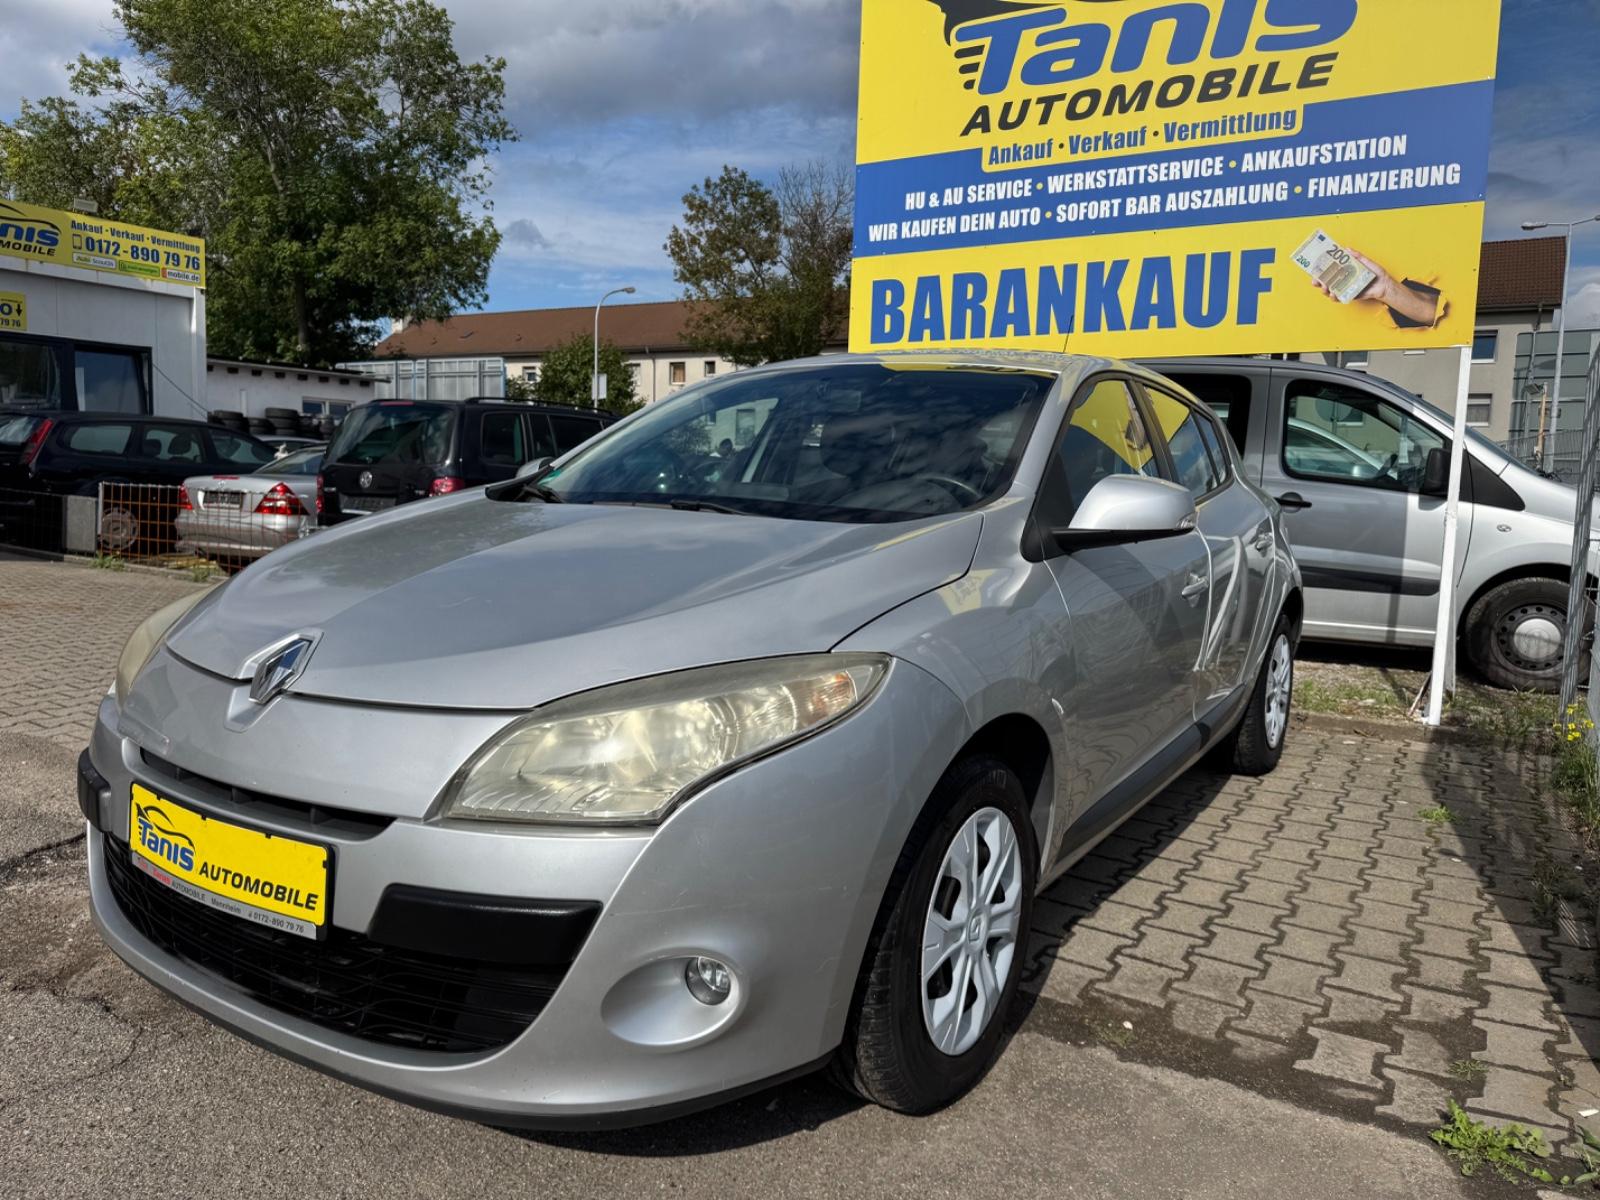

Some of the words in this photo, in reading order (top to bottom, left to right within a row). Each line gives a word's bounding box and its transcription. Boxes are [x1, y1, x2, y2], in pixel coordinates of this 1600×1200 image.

[960, 52, 1339, 137] AUTOMOBILE
[988, 138, 1054, 166] Ankauf
[1068, 125, 1147, 155] Verkauf
[1163, 109, 1297, 143] Vermittlung
[905, 191, 926, 211] HU
[929, 191, 940, 208] &
[943, 186, 964, 206] AU
[967, 178, 1033, 204] SERVICE
[1047, 156, 1224, 195] WERKSTATTSERVICE
[1241, 134, 1407, 173] ANKAUFSTATION
[868, 222, 899, 242] WIR
[901, 216, 957, 239] KAUFEN
[959, 211, 996, 233] DEIN
[998, 207, 1041, 229] AUTO
[1056, 198, 1122, 223] SOFORT
[1125, 194, 1161, 217] BAR
[1165, 181, 1289, 213] AUSZAHLUNG
[1307, 162, 1462, 199] FINANZIERUNG
[71, 220, 103, 235] Ankauf
[110, 227, 145, 243] Verkauf
[150, 235, 201, 255] Vermittlung
[163, 250, 181, 267] 79
[183, 254, 201, 271] 76
[1326, 243, 1351, 266] 200
[869, 247, 1277, 345] BARANKAUF
[199, 861, 319, 911] AUTOMOBILE
